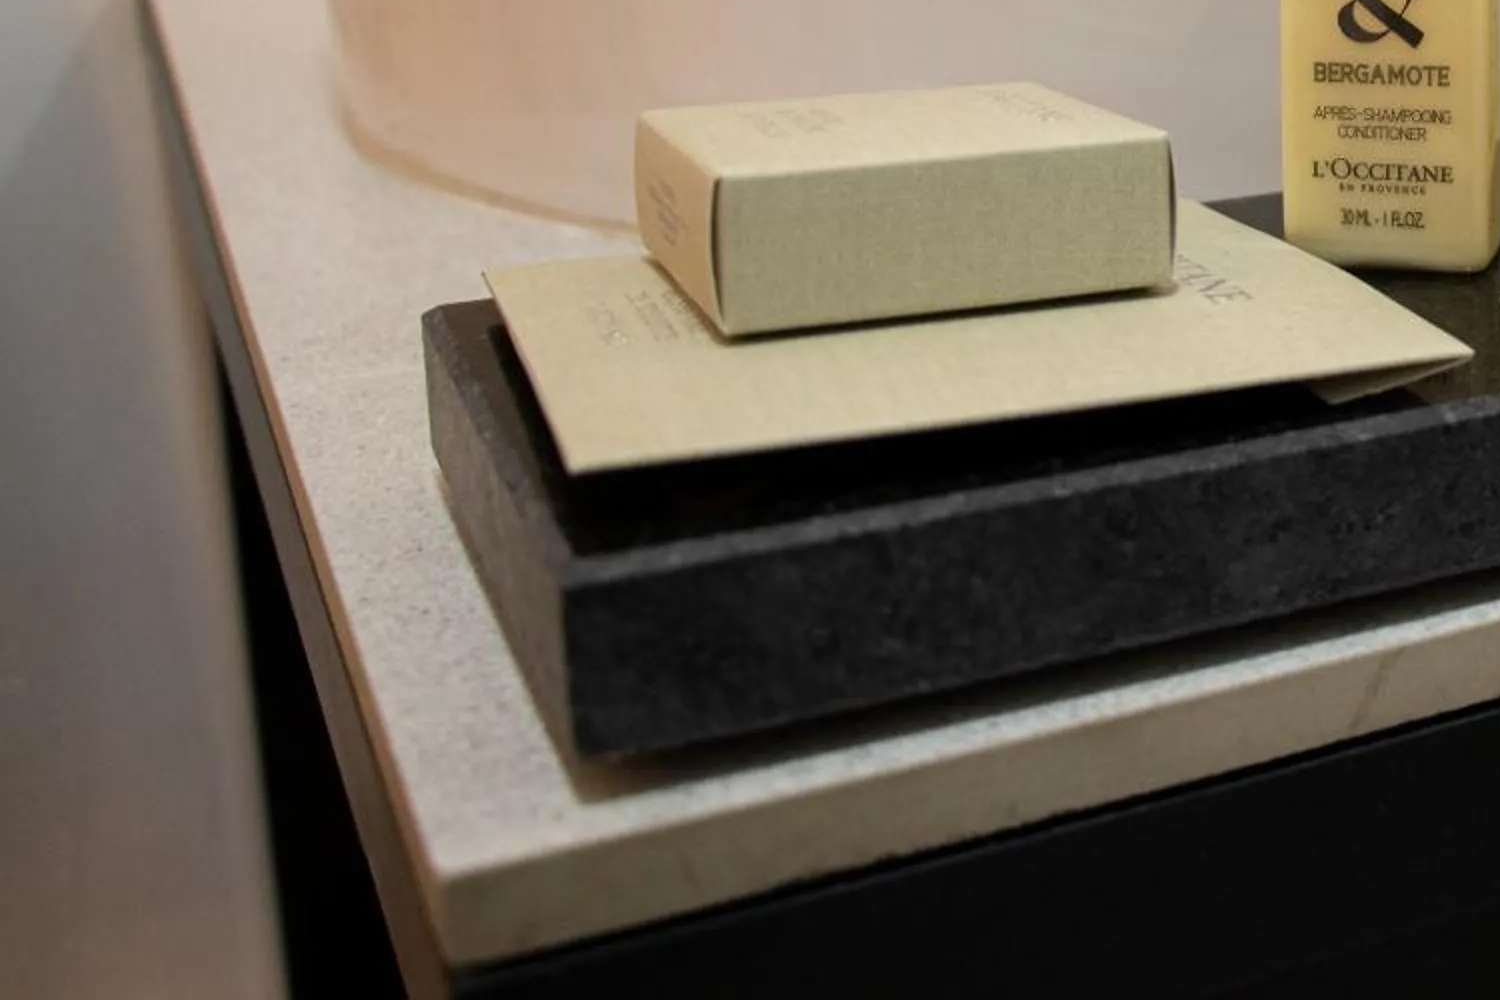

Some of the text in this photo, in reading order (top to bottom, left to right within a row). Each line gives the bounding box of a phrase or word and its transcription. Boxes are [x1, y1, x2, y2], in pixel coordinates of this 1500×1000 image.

[1313, 61, 1451, 88] BERGAMOTE
[1337, 124, 1428, 142] CONDITIONER
[1312, 157, 1455, 184] L'OCCITANE
[1360, 183, 1427, 196] PROVENCE
